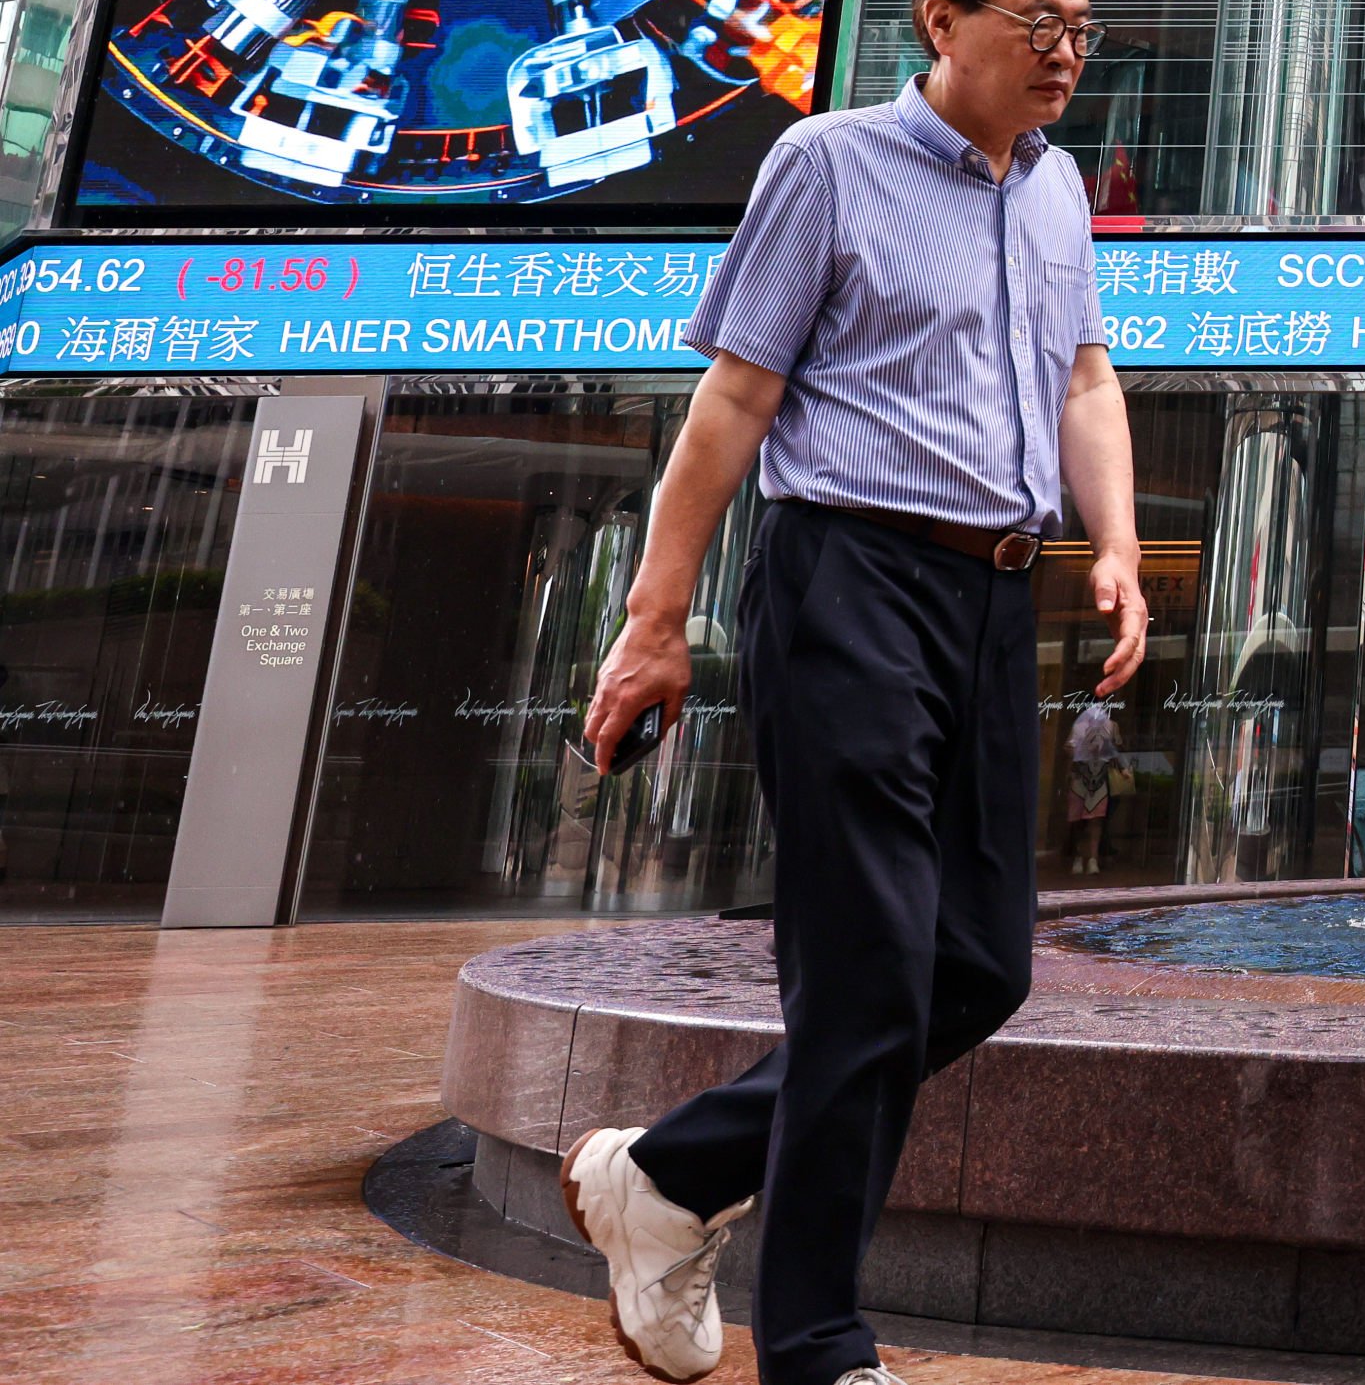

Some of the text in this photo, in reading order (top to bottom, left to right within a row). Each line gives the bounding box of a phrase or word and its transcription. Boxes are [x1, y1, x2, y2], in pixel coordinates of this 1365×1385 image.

[56, 315, 260, 364] 海爾智家
[279, 318, 411, 354] HAIER
[1183, 310, 1332, 358] 海底撈
[241, 624, 309, 637] One & Two
[246, 639, 307, 653] Exchange
[259, 653, 304, 668] Square
